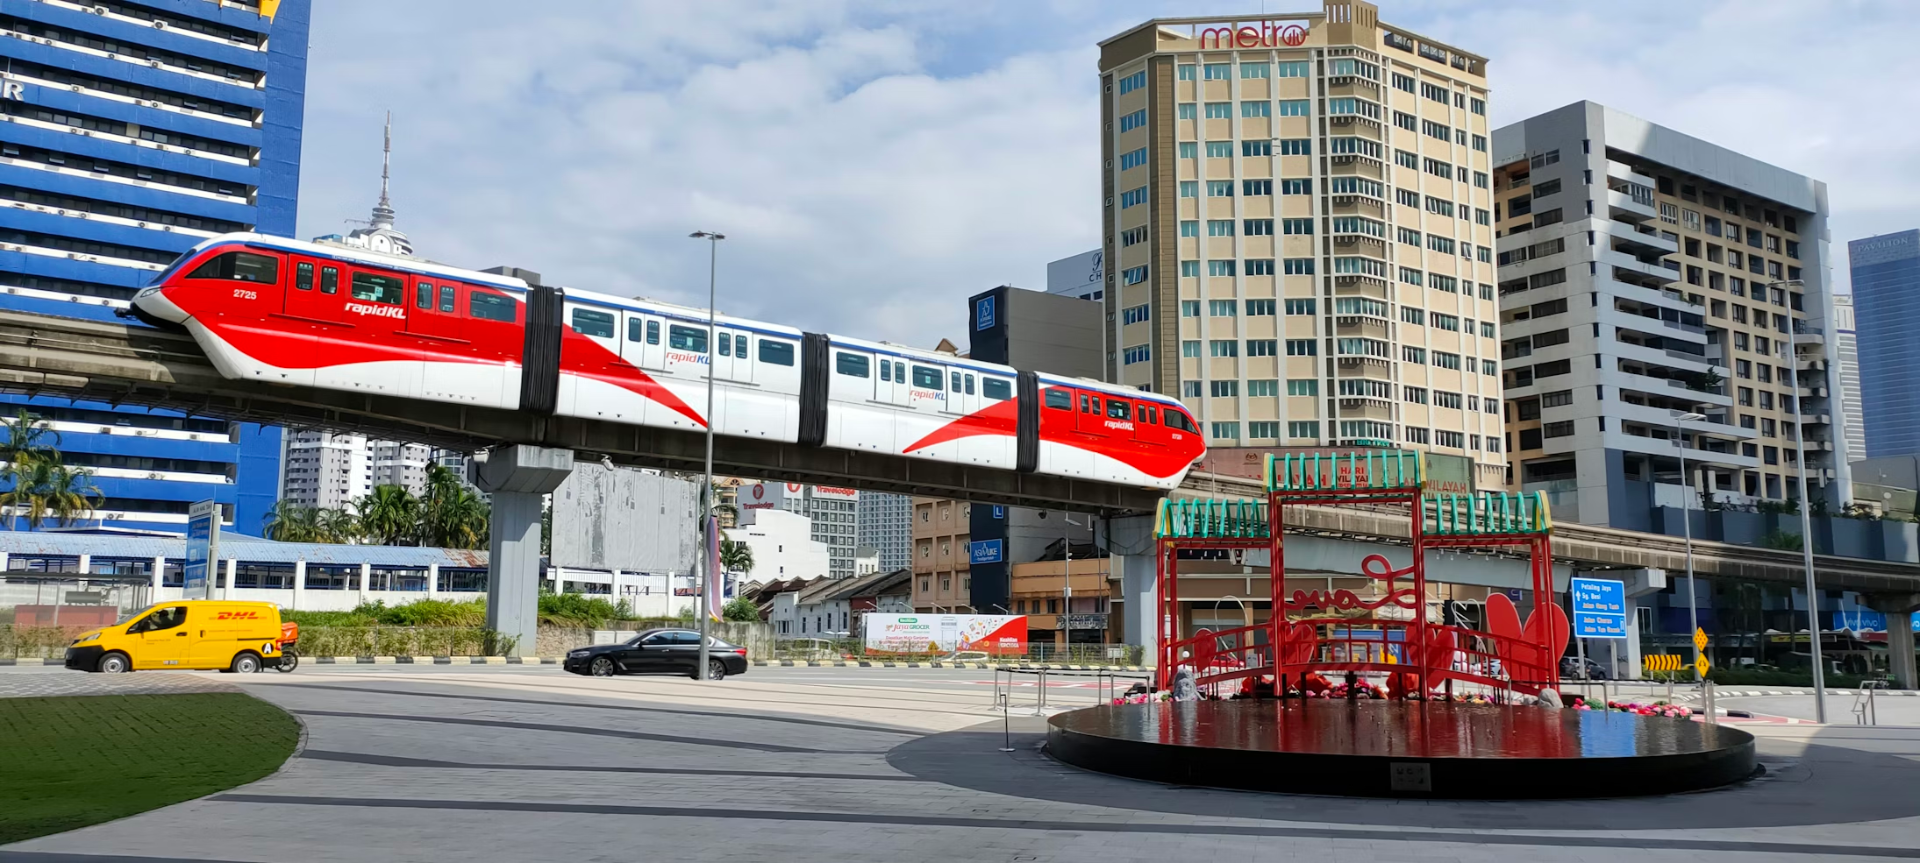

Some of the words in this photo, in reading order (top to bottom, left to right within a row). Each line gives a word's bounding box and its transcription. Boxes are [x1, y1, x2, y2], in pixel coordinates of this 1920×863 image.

[1201, 19, 1306, 49] metro
[1858, 237, 1908, 252] PAVILION
[233, 289, 257, 300] 2725
[344, 302, 406, 319] rapidKL
[666, 352, 710, 365] rapidKL
[910, 390, 946, 401] rapidKL
[1104, 420, 1134, 431] rapidKL
[1426, 478, 1467, 494] WILAYAH
[743, 502, 774, 510] Travelodge
[1581, 583, 1600, 592] Petaling
[217, 612, 259, 620] DHL
[1862, 618, 1878, 627] vivo
[263, 642, 272, 654] A
